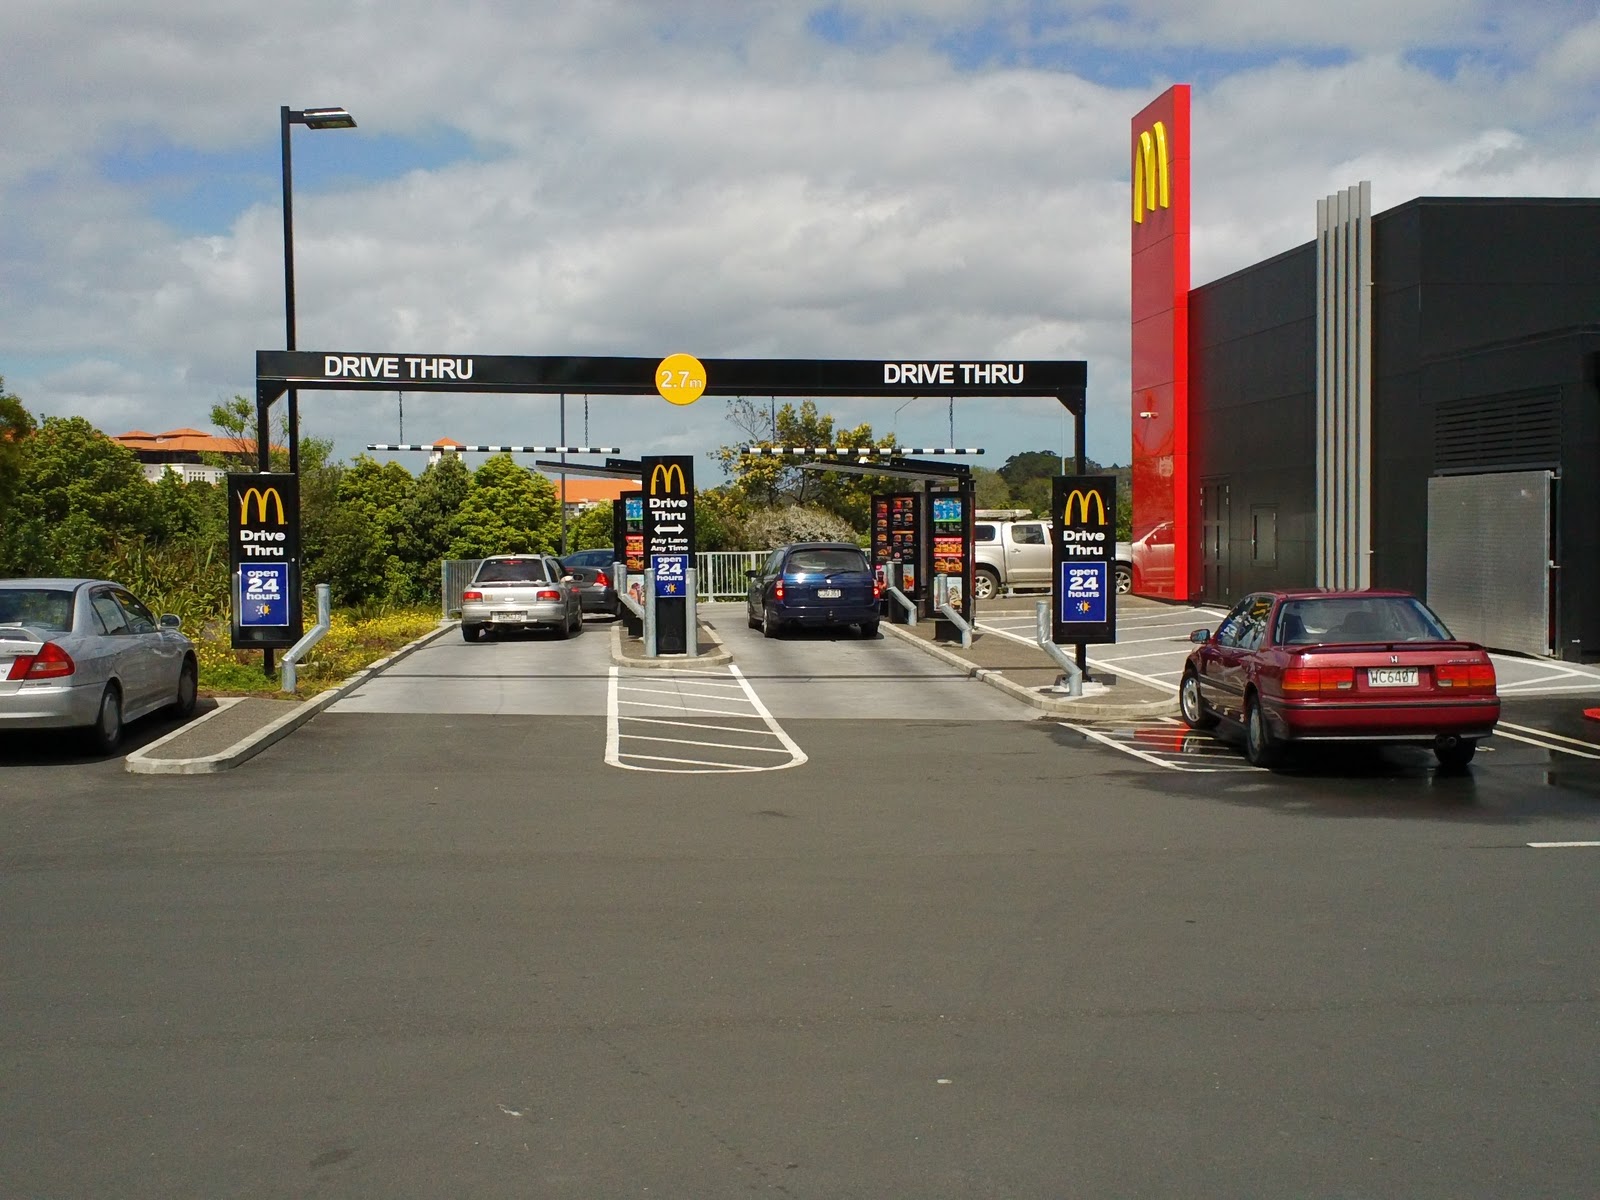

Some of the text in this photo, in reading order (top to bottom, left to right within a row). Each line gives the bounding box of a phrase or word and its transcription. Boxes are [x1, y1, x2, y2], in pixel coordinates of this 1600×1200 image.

[324, 355, 473, 380] DRIVE THRU
[660, 370, 702, 388] 2.7m
[883, 363, 1024, 384] DRIVE THRU
[649, 498, 688, 508] Drive
[652, 511, 686, 521] Thru
[240, 530, 286, 541] Drive
[651, 537, 666, 545] Any
[1063, 530, 1105, 541] Drive
[243, 545, 284, 556] Thru
[651, 545, 666, 553] Any
[1066, 544, 1103, 555] Thru
[657, 556, 682, 564] open
[657, 563, 682, 575] 24
[1069, 568, 1099, 577] open
[247, 570, 279, 580] open
[247, 578, 279, 593] 24
[1069, 576, 1099, 591] 24
[246, 592, 281, 601] hours
[1067, 590, 1100, 598] hours
[1370, 669, 1416, 684] WC6407
